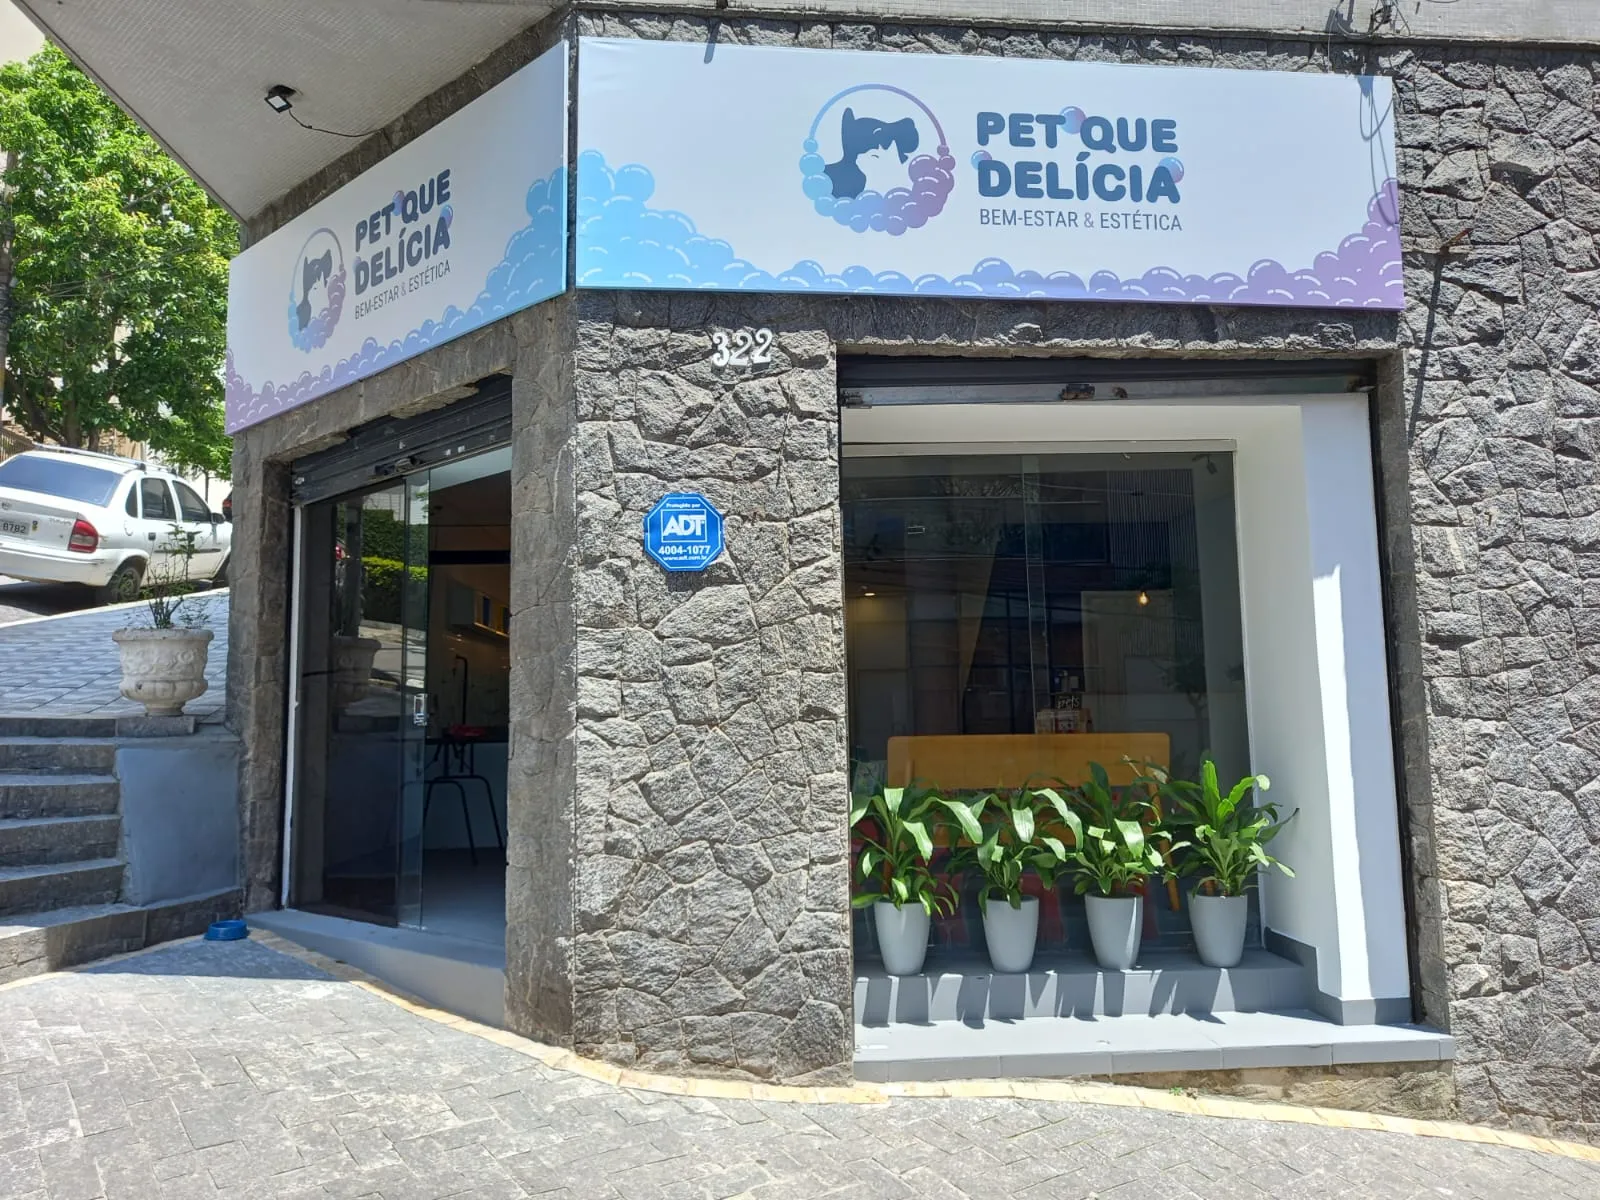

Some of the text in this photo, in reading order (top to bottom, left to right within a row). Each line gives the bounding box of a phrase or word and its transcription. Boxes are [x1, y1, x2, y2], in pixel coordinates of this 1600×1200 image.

[977, 111, 1179, 154] PET QUE
[977, 151, 1182, 204] DELÍCIA
[355, 168, 451, 252] PET QUE
[979, 208, 1183, 232] BEM-ESTAR & ESTÉTICA
[355, 216, 451, 296] DELÍCIA
[354, 259, 451, 320] BEM-ESTAR & ESTÉTICA
[712, 327, 773, 367] 322
[663, 513, 706, 537] ADT
[658, 545, 712, 555] 4004-1077
